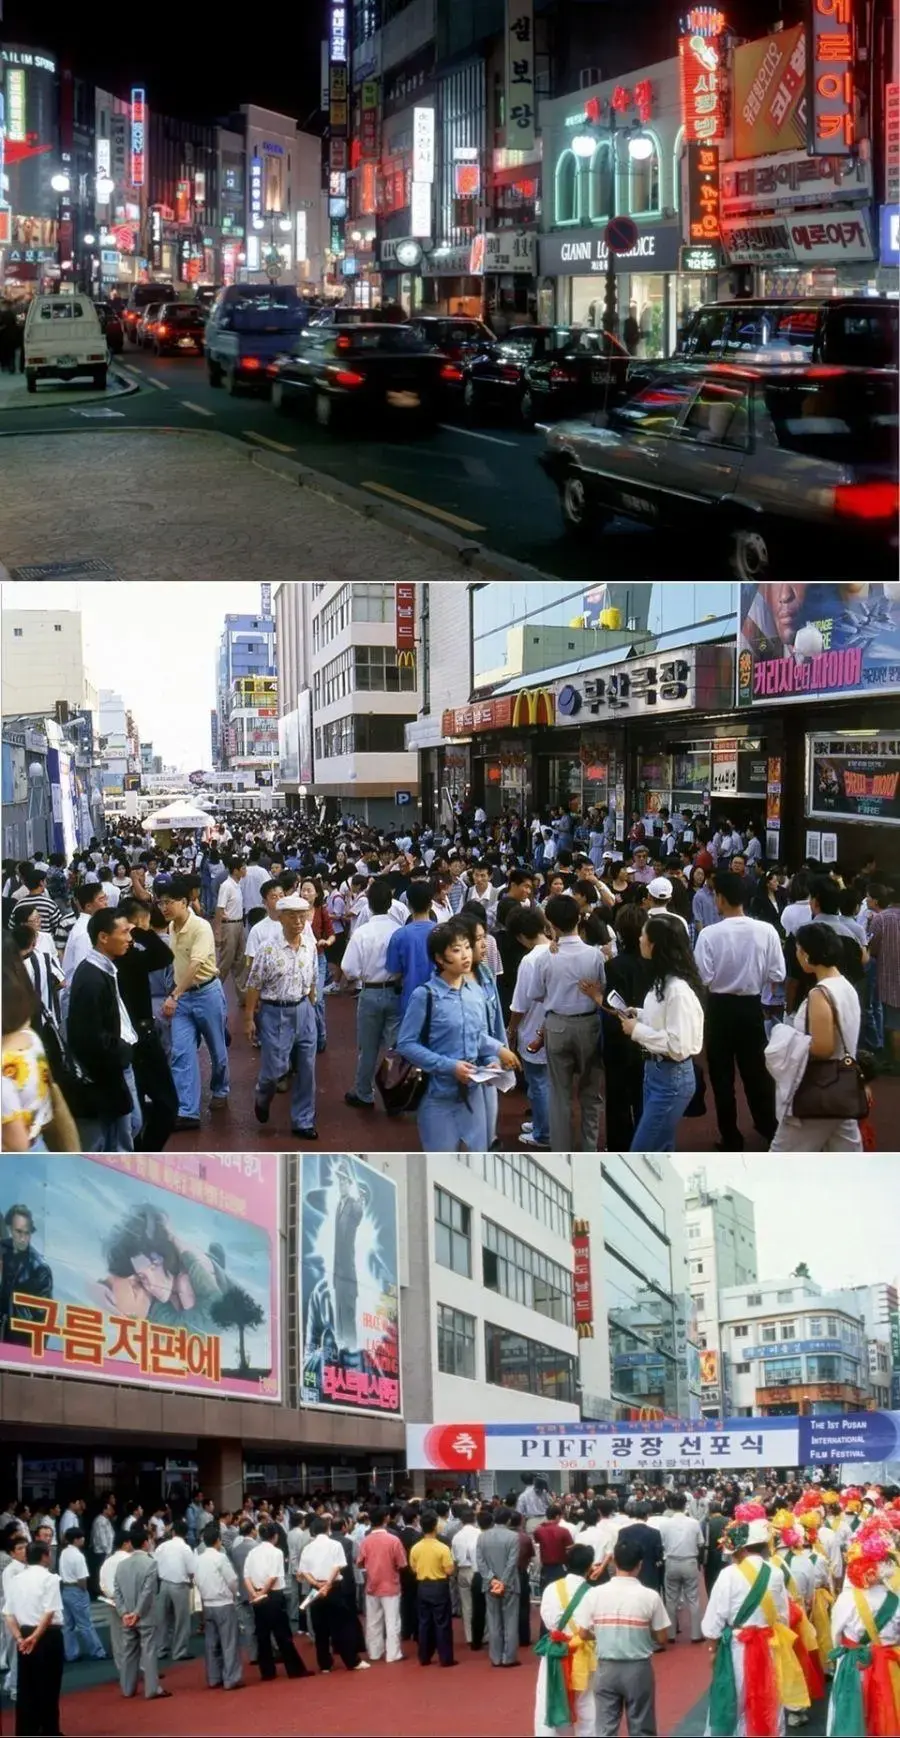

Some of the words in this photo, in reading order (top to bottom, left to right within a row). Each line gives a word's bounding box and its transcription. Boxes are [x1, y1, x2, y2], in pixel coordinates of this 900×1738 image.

[816, 0, 854, 146] 에로이카
[792, 221, 866, 250] 에로이카
[561, 242, 591, 261] GIANNI
[754, 657, 793, 694] 커리지
[811, 648, 862, 688] 파이어
[583, 659, 690, 713] 부산극장
[574, 1247, 590, 1311] 맥도날드
[811, 1420, 824, 1429] THE
[842, 1420, 867, 1429] PUSAN
[452, 1432, 478, 1460] 축
[520, 1439, 597, 1458] PIFF
[611, 1436, 663, 1457] 광장
[679, 1434, 764, 1456] 선포식
[811, 1436, 865, 1445] INTERNATIONAL
[638, 1458, 705, 1468] 부산광역시
[810, 1450, 828, 1459] FILM
[831, 1450, 866, 1458] FESTIVAL
